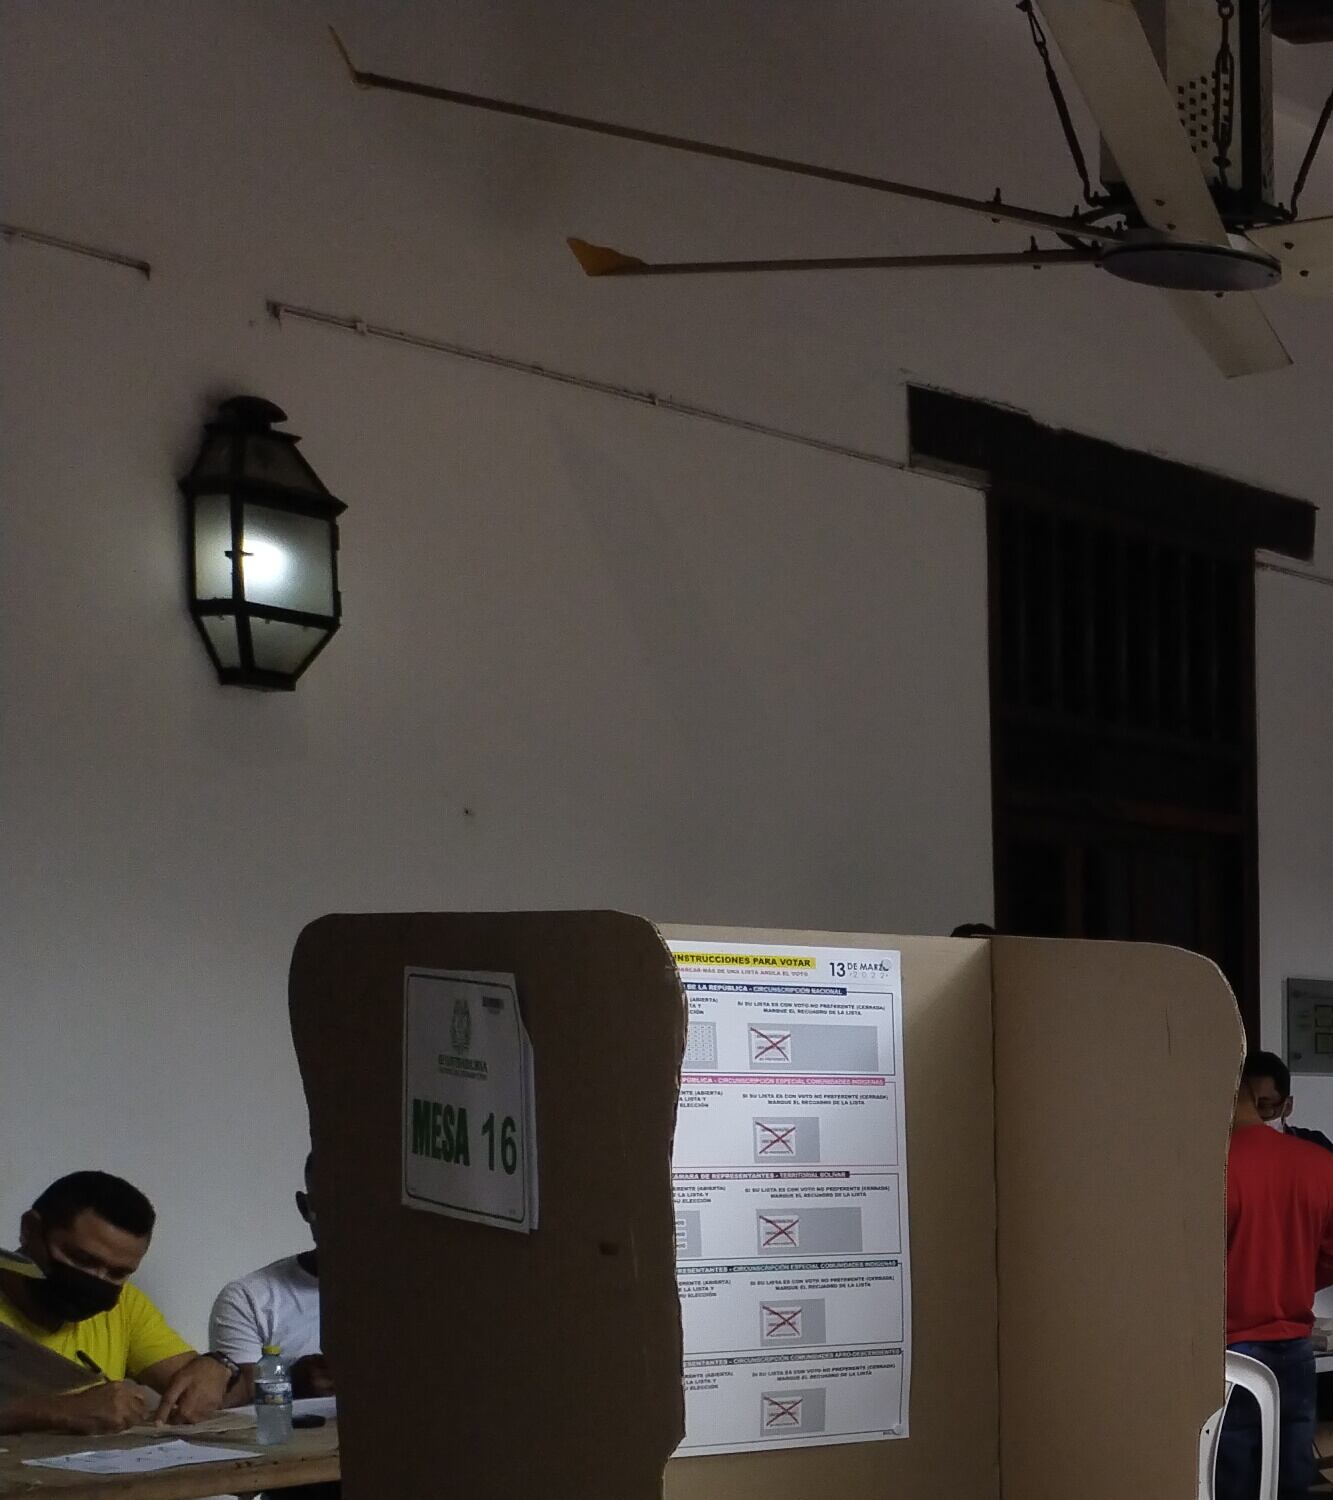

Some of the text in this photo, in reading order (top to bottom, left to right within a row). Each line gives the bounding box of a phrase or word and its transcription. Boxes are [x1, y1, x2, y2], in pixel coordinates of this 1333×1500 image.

[674, 954, 750, 964] INSTRUCCIONES
[781, 958, 810, 967] VOTAR
[830, 962, 846, 977] 13
[848, 962, 857, 970] DE
[412, 1098, 517, 1176] MESA 16
